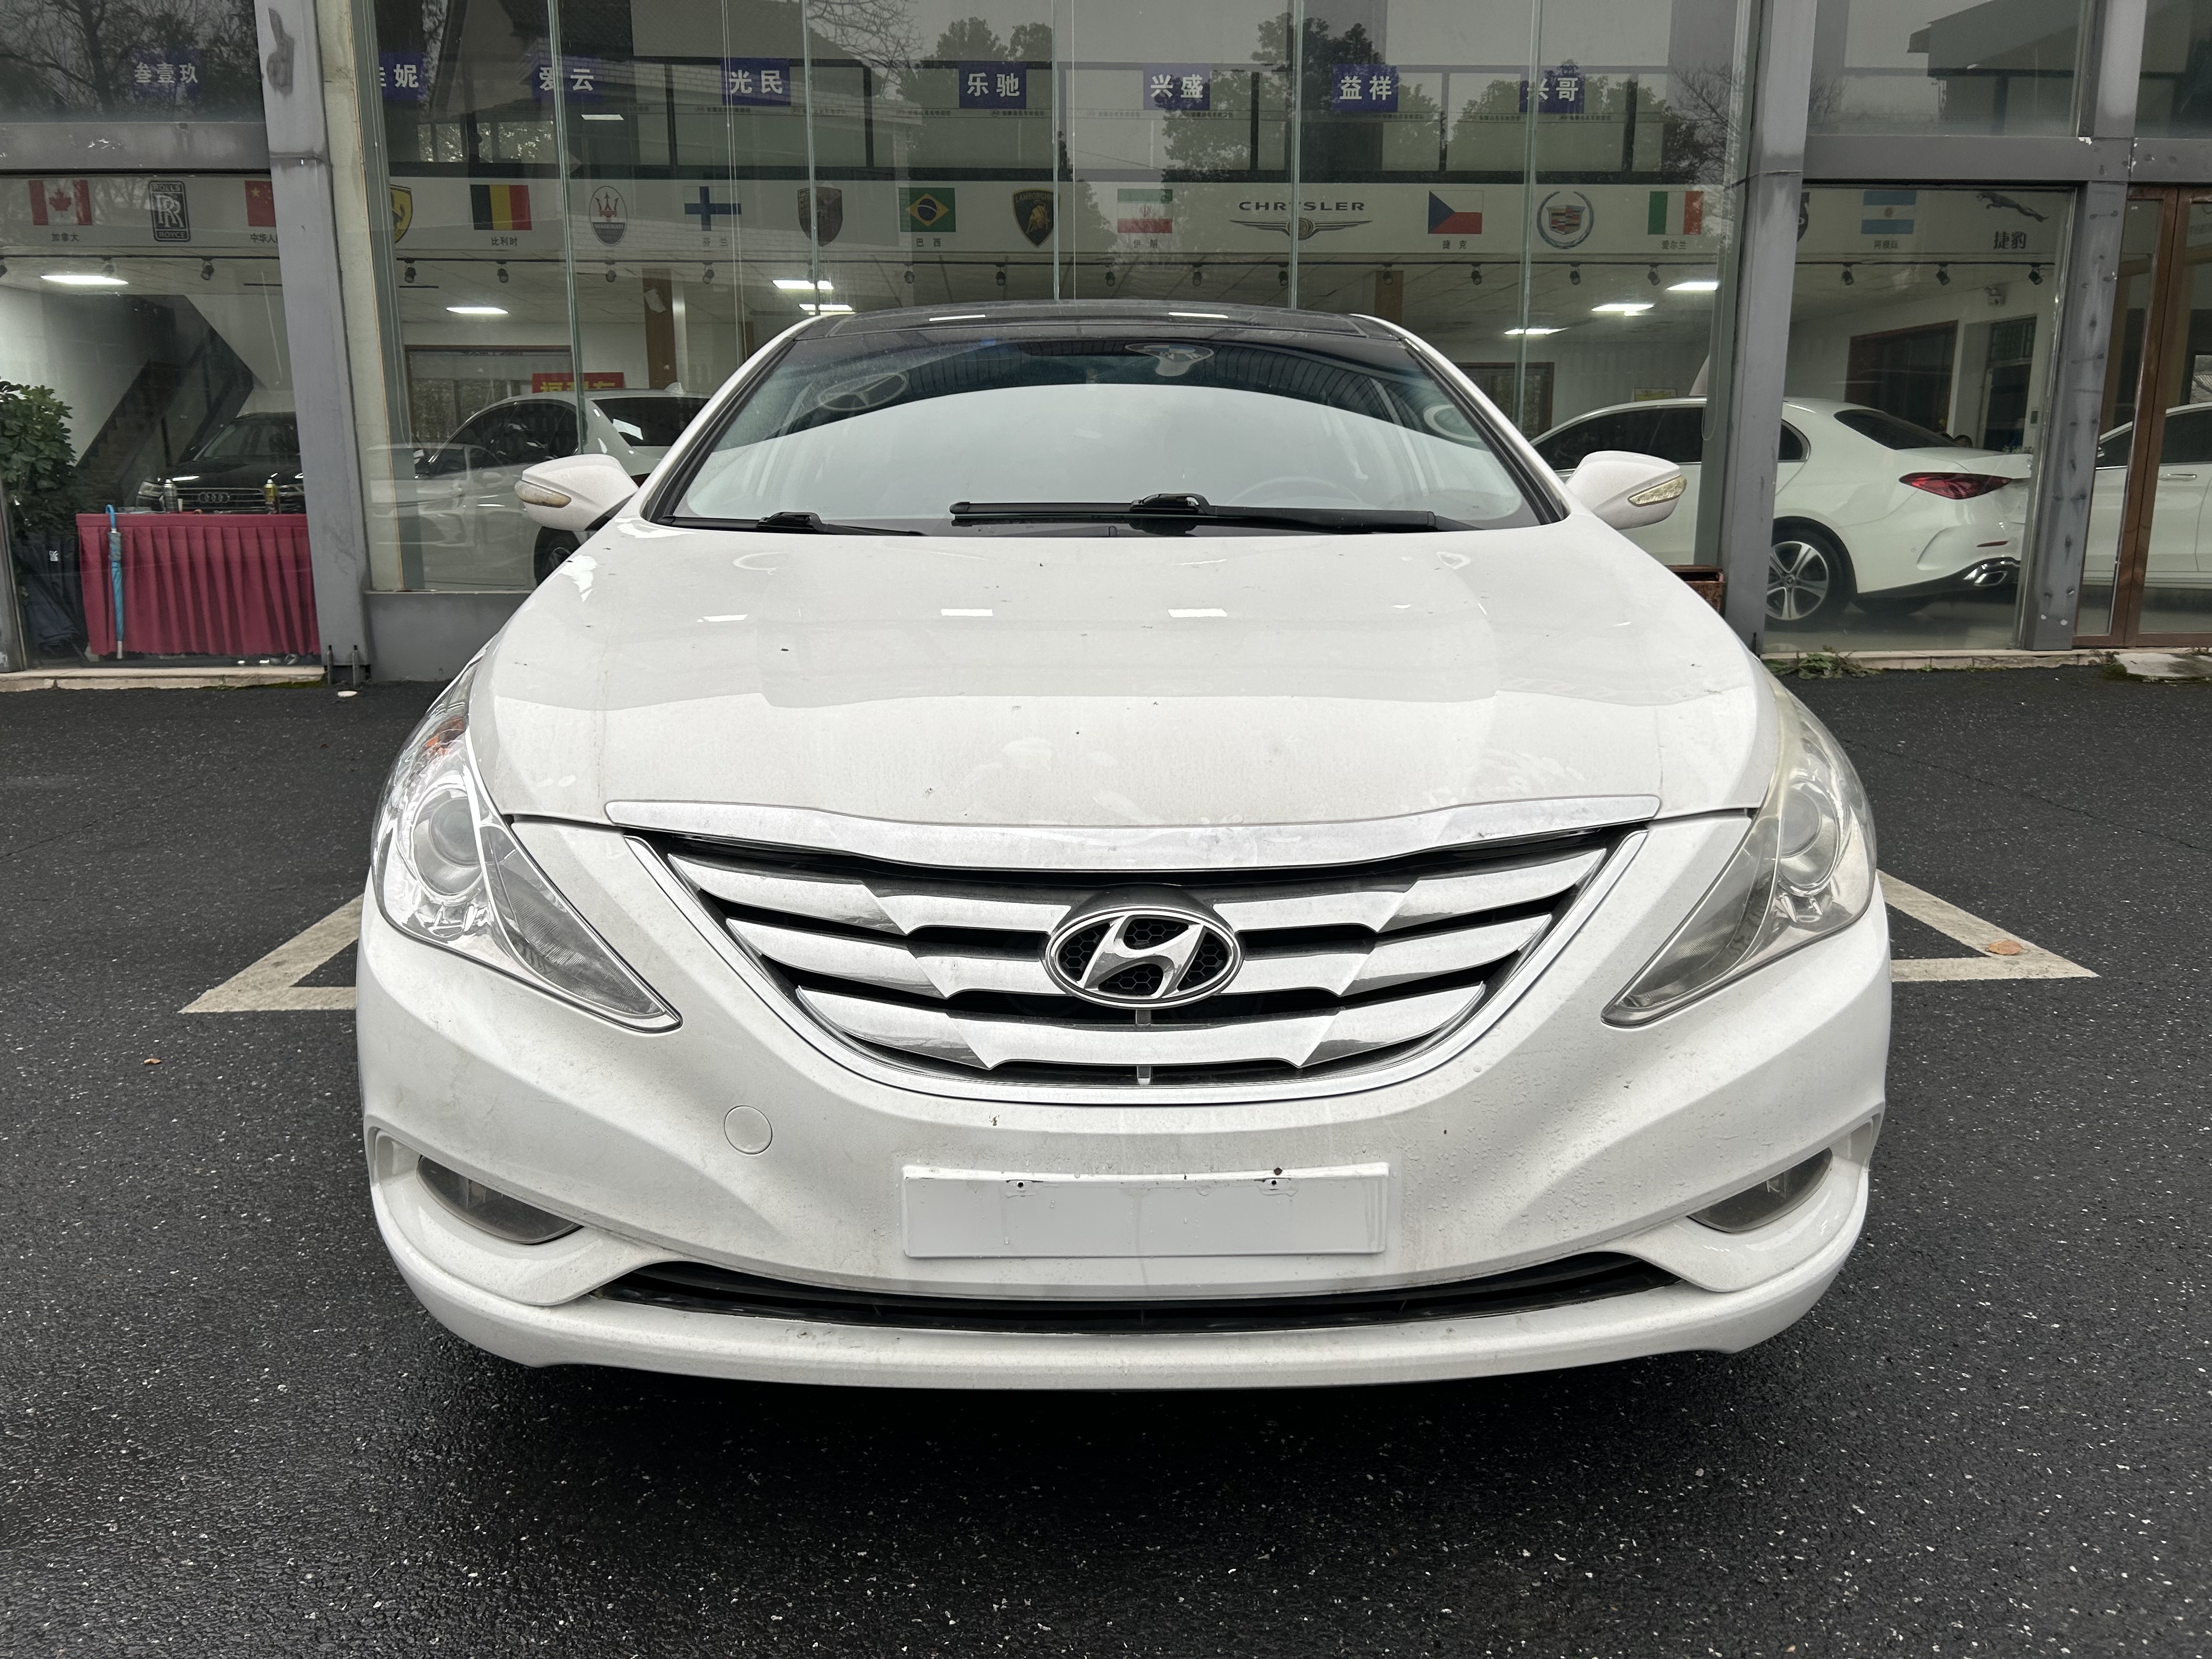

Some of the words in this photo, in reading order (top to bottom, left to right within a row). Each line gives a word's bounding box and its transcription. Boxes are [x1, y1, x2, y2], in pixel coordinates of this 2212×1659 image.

[134, 62, 199, 84] 叁壹玖
[729, 69, 783, 94] 光民
[967, 72, 1020, 97] 乐驰
[1150, 74, 1203, 98] 兴盛
[1339, 75, 1392, 100] 益祥
[1239, 201, 1365, 211] CHRSLER
[250, 233, 278, 243] 中华人
[491, 236, 517, 246] 比利时
[916, 238, 941, 247] 巴西
[1993, 231, 2027, 250] 捷豹
